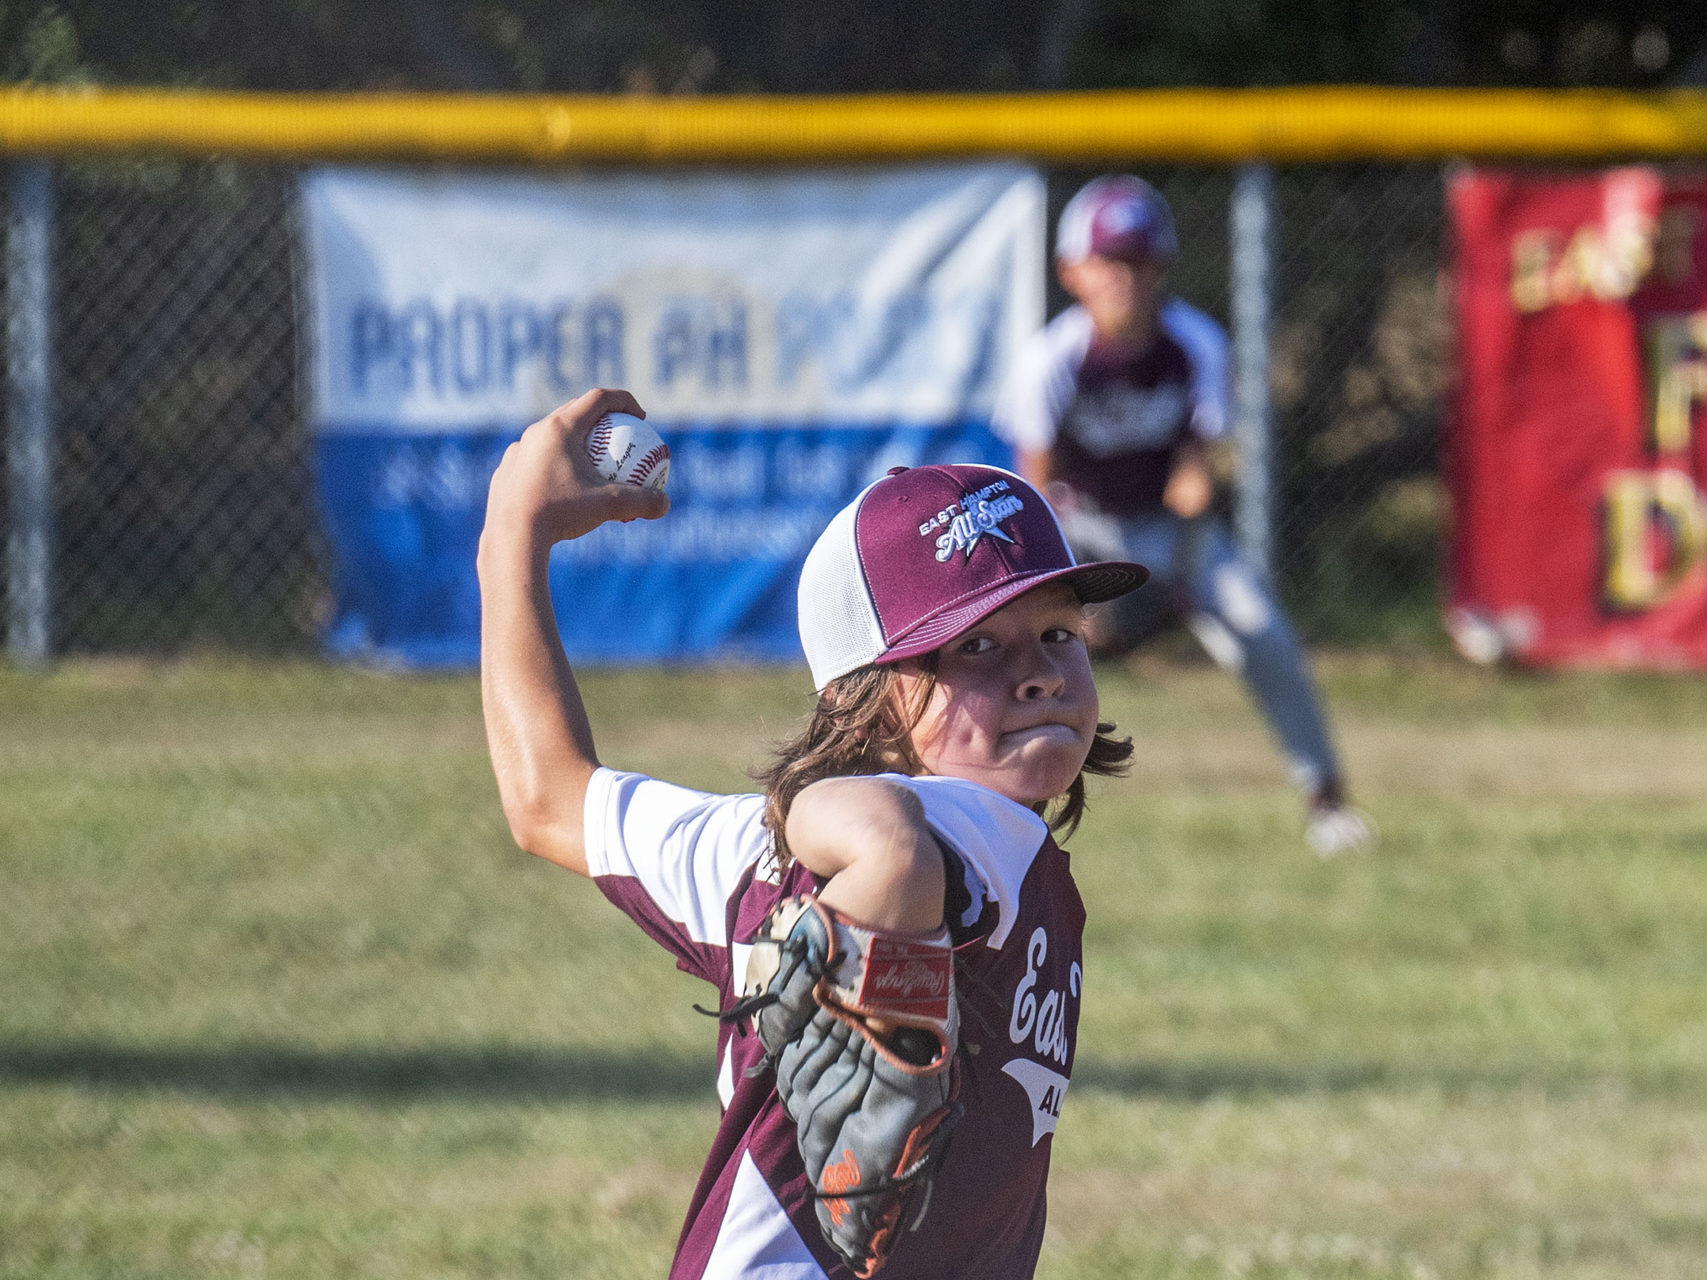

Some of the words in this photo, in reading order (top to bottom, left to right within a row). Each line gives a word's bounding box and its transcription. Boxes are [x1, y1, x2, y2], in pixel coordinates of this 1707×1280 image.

[918, 504, 958, 537] EAST
[960, 479, 1011, 511] HAMPTON
[935, 510, 979, 562] All
